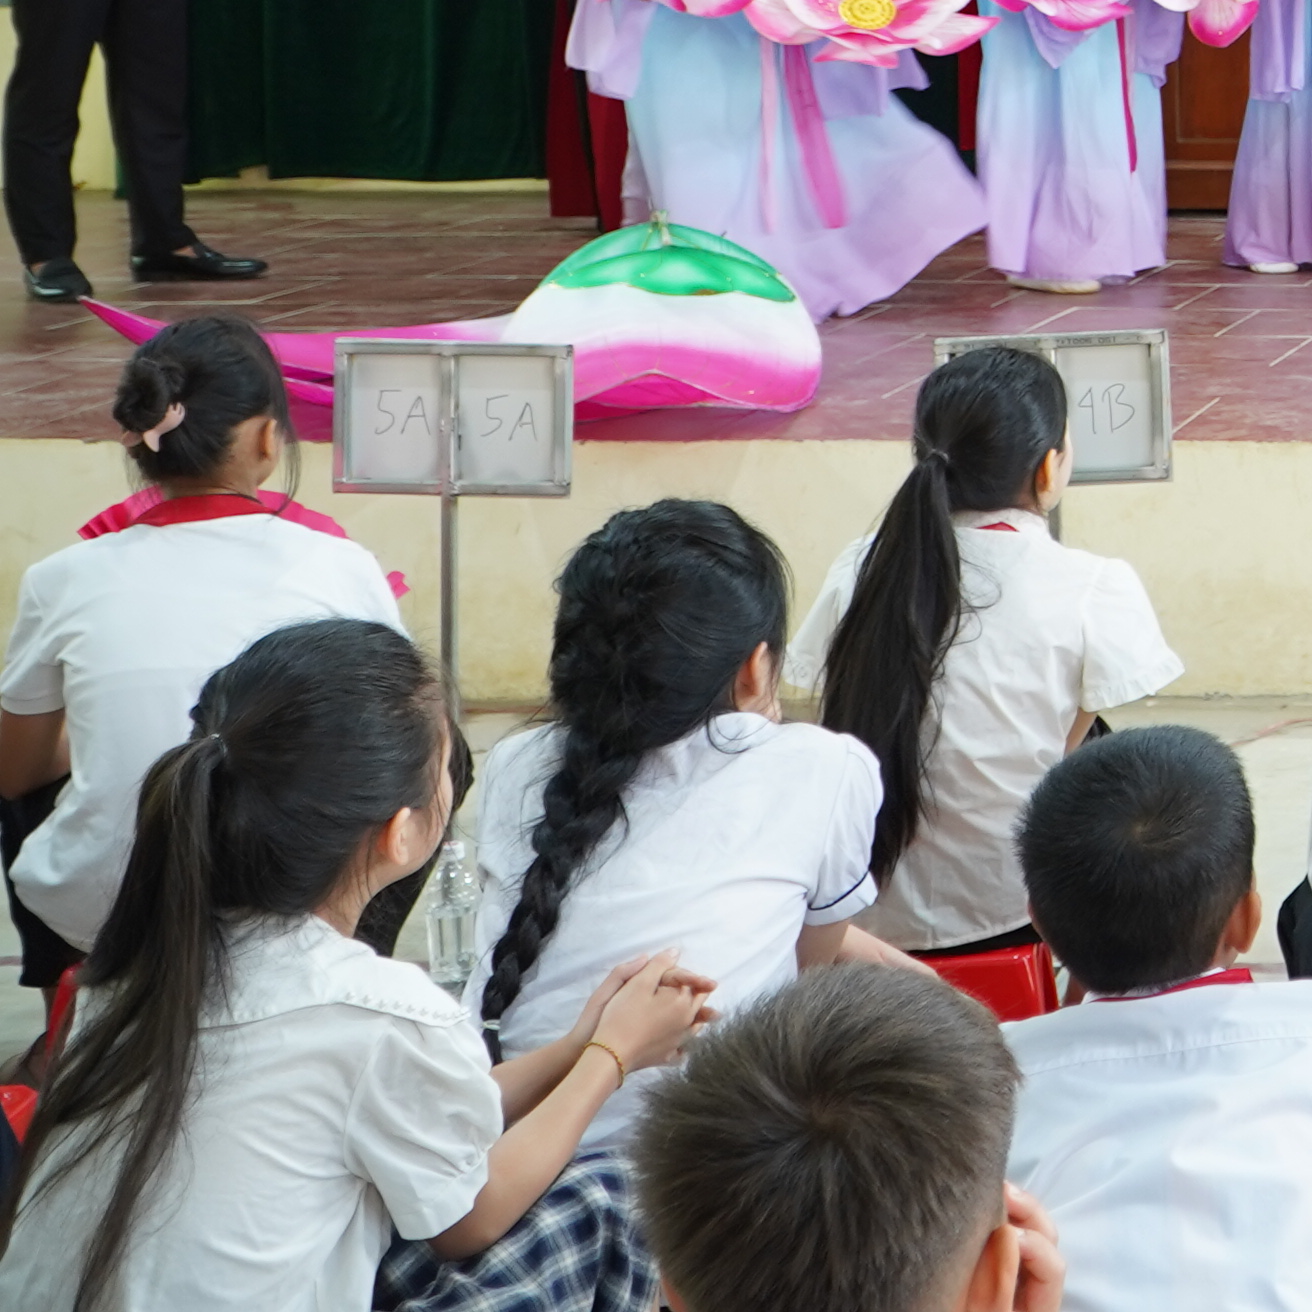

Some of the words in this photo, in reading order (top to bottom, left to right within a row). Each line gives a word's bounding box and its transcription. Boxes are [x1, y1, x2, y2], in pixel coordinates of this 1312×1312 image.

[374, 389, 431, 436] 5A
[481, 394, 538, 442] 5A
[1078, 383, 1135, 435] 4B
